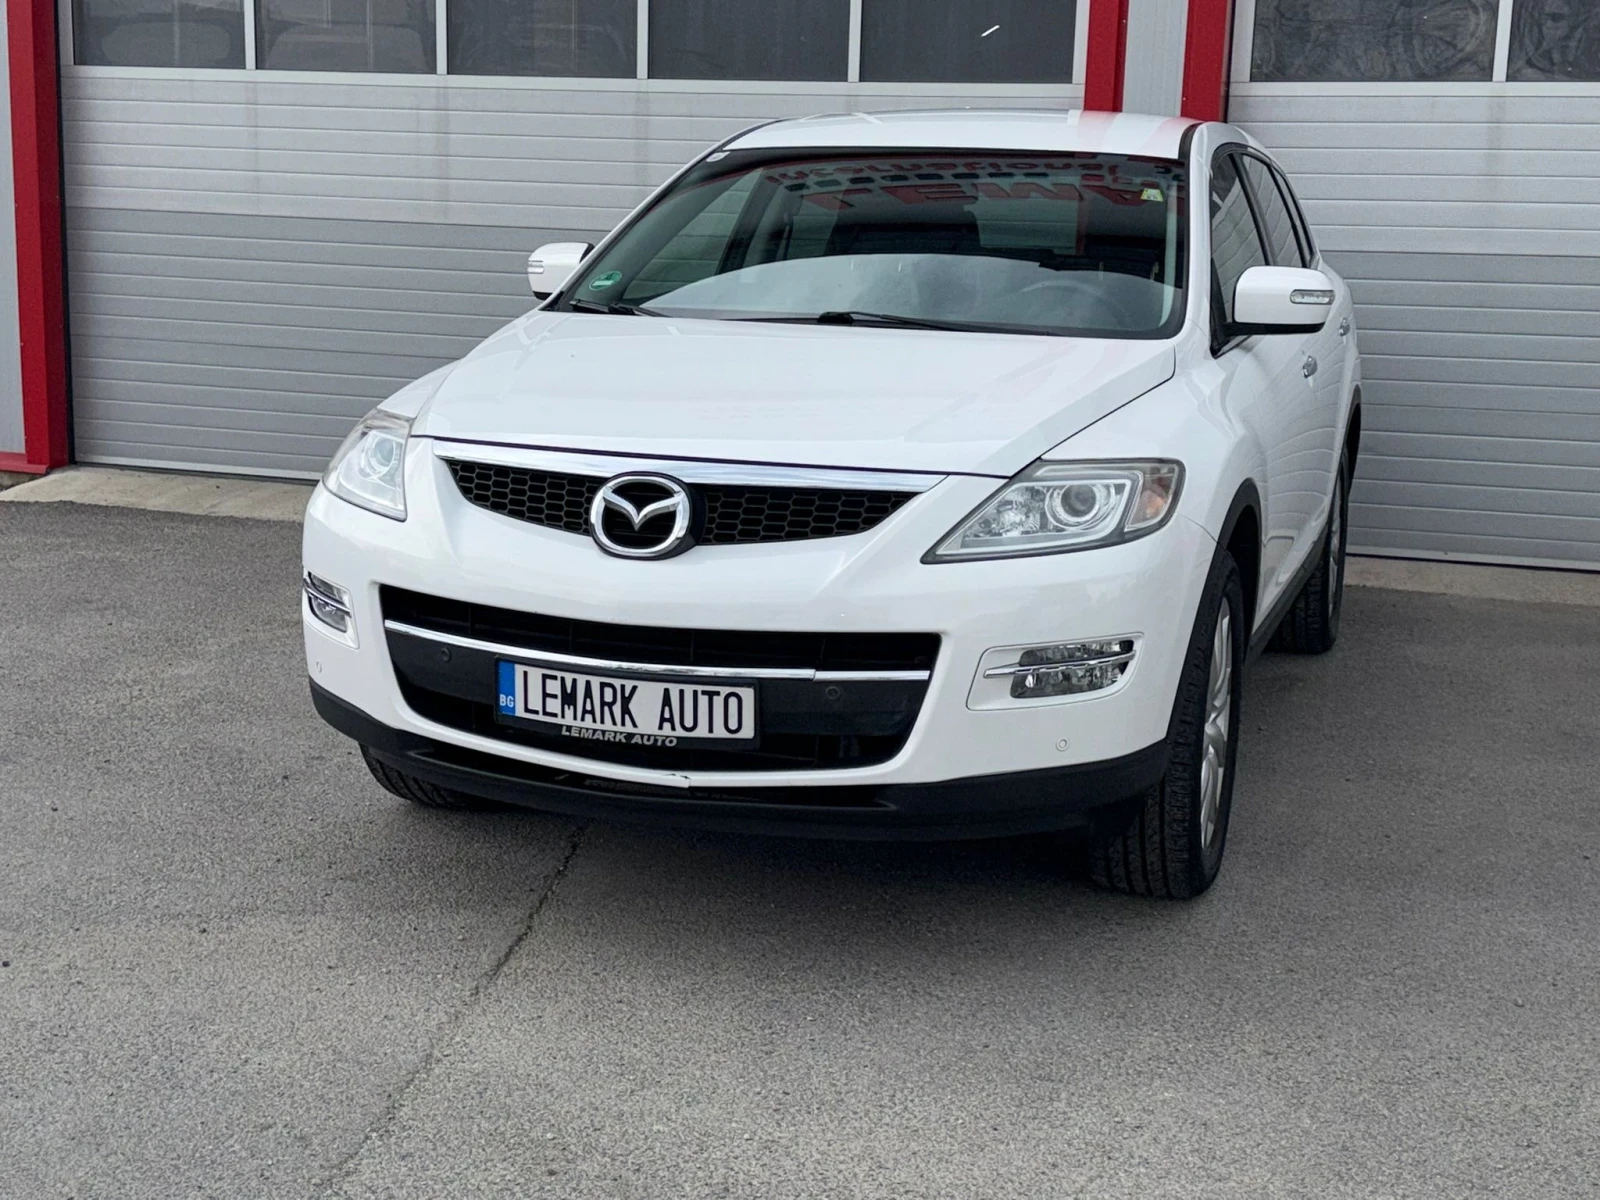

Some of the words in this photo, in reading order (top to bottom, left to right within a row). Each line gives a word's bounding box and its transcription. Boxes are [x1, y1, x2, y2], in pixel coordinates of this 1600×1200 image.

[499, 694, 515, 708] BG
[523, 670, 638, 729] LEMARK
[658, 687, 743, 735] AUTO
[561, 725, 627, 743] LEMARK
[630, 733, 677, 747] AUTO
